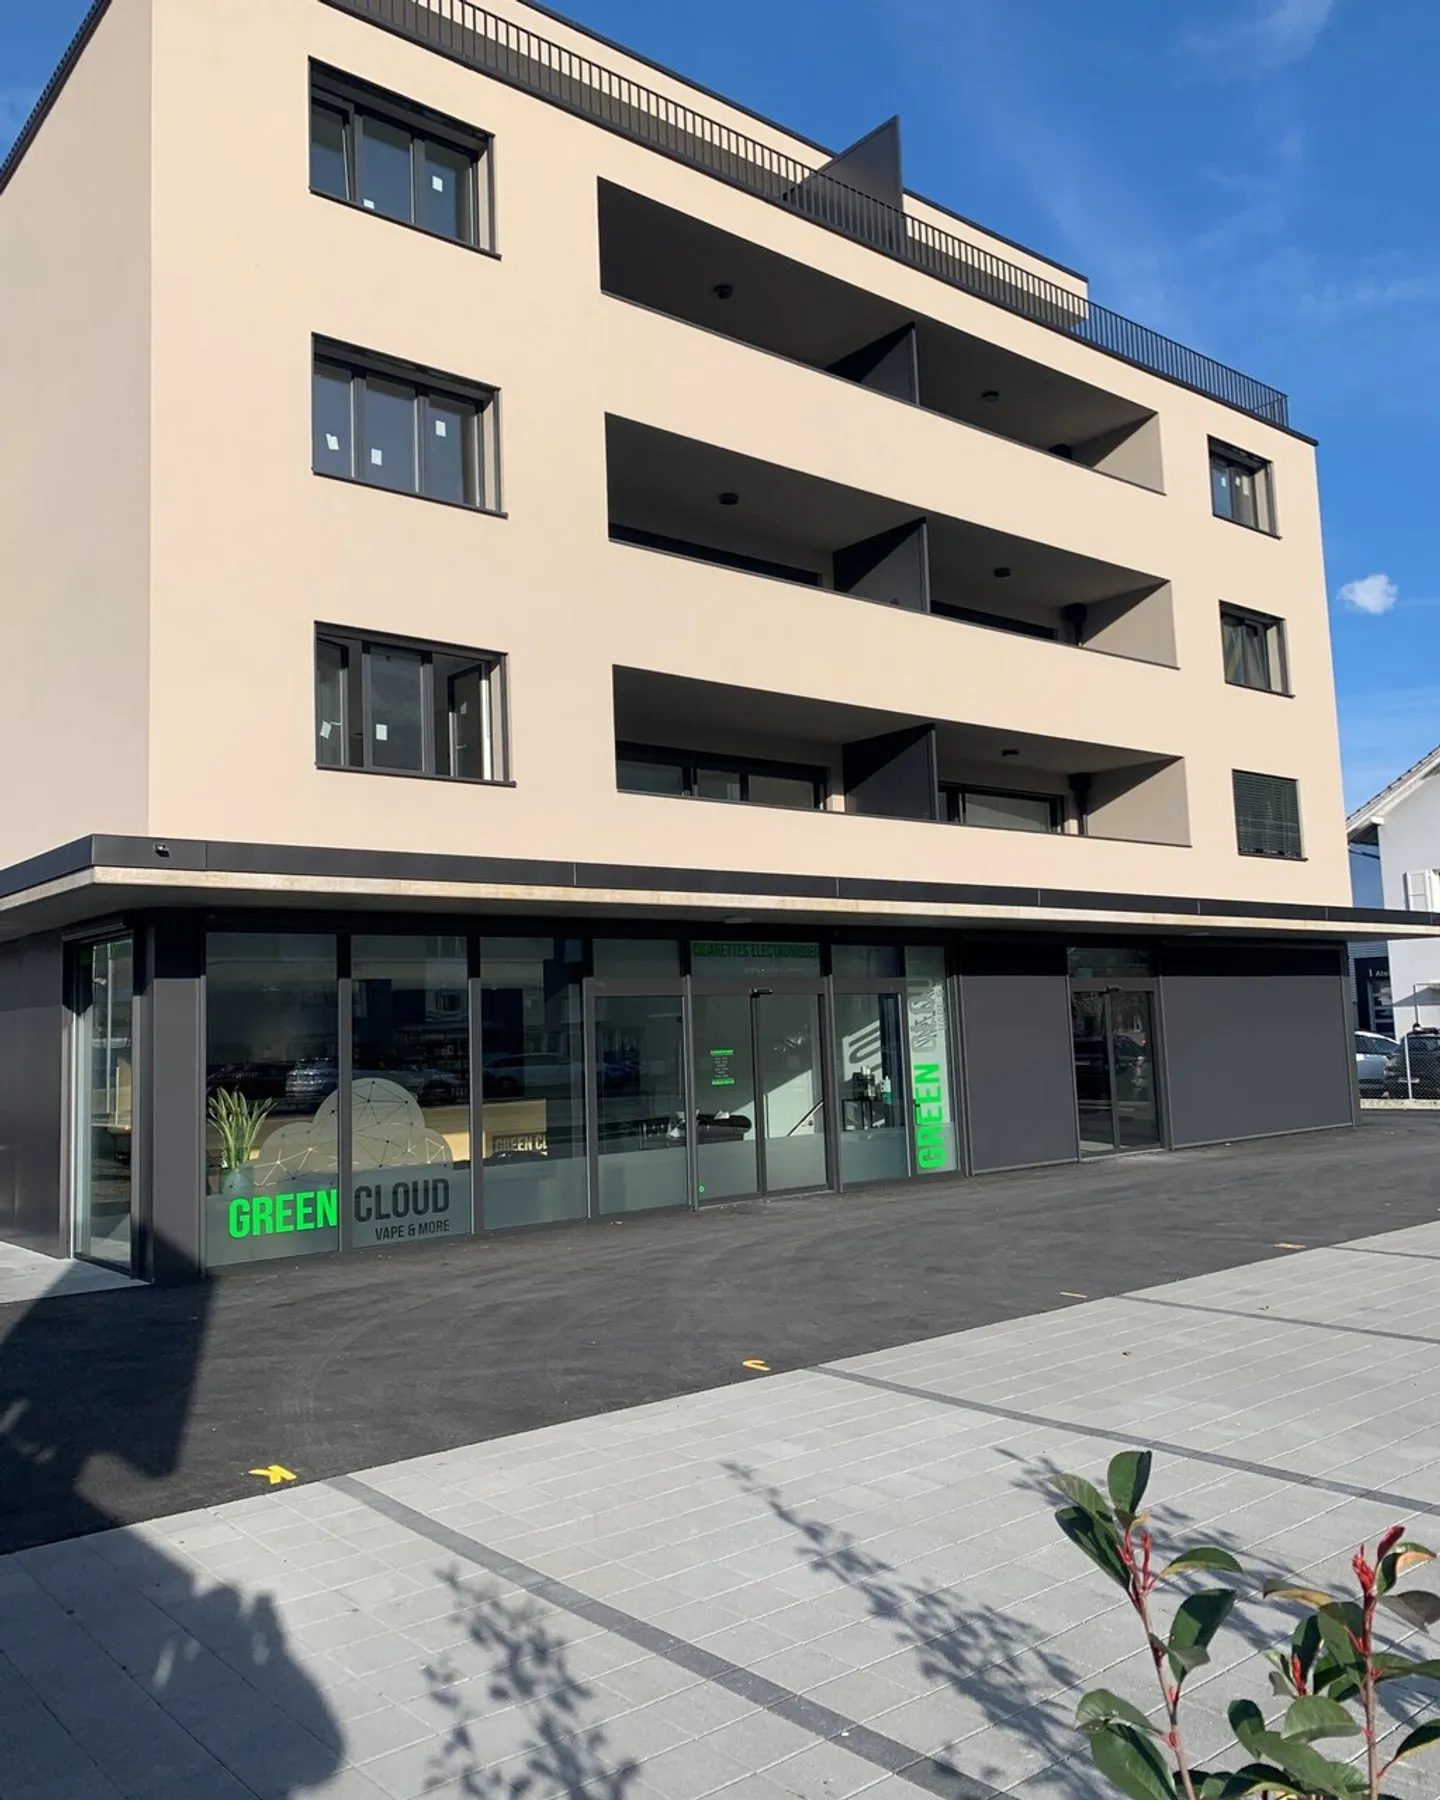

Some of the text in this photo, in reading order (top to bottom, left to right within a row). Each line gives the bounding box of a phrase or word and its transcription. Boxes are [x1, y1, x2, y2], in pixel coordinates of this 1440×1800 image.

[913, 1063, 946, 1168] GREEN
[229, 1178, 450, 1239] GREEN CLOUD
[375, 1219, 450, 1240] VAPE & MORE
